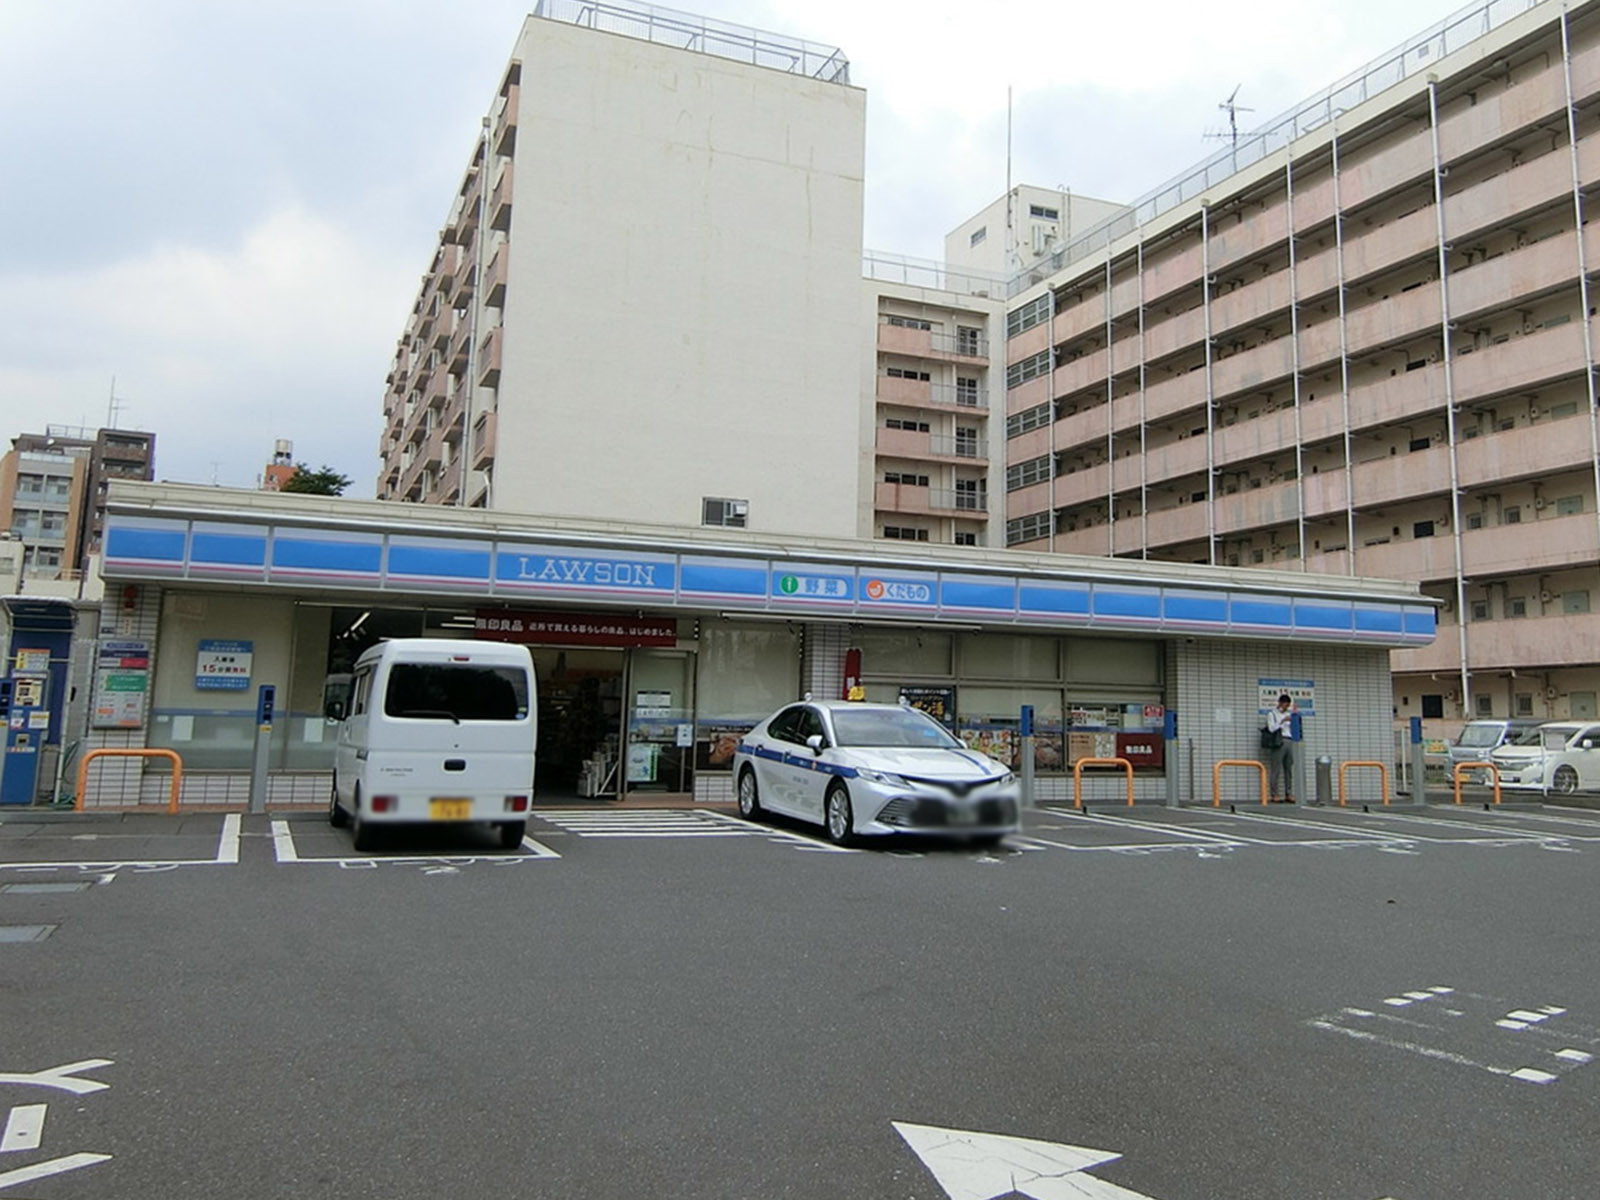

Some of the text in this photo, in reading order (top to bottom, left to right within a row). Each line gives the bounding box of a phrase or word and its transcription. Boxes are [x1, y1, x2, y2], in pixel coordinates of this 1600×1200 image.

[518, 556, 656, 587] LAWSON
[886, 583, 928, 600] くだもの
[475, 617, 524, 633] 無印良品
